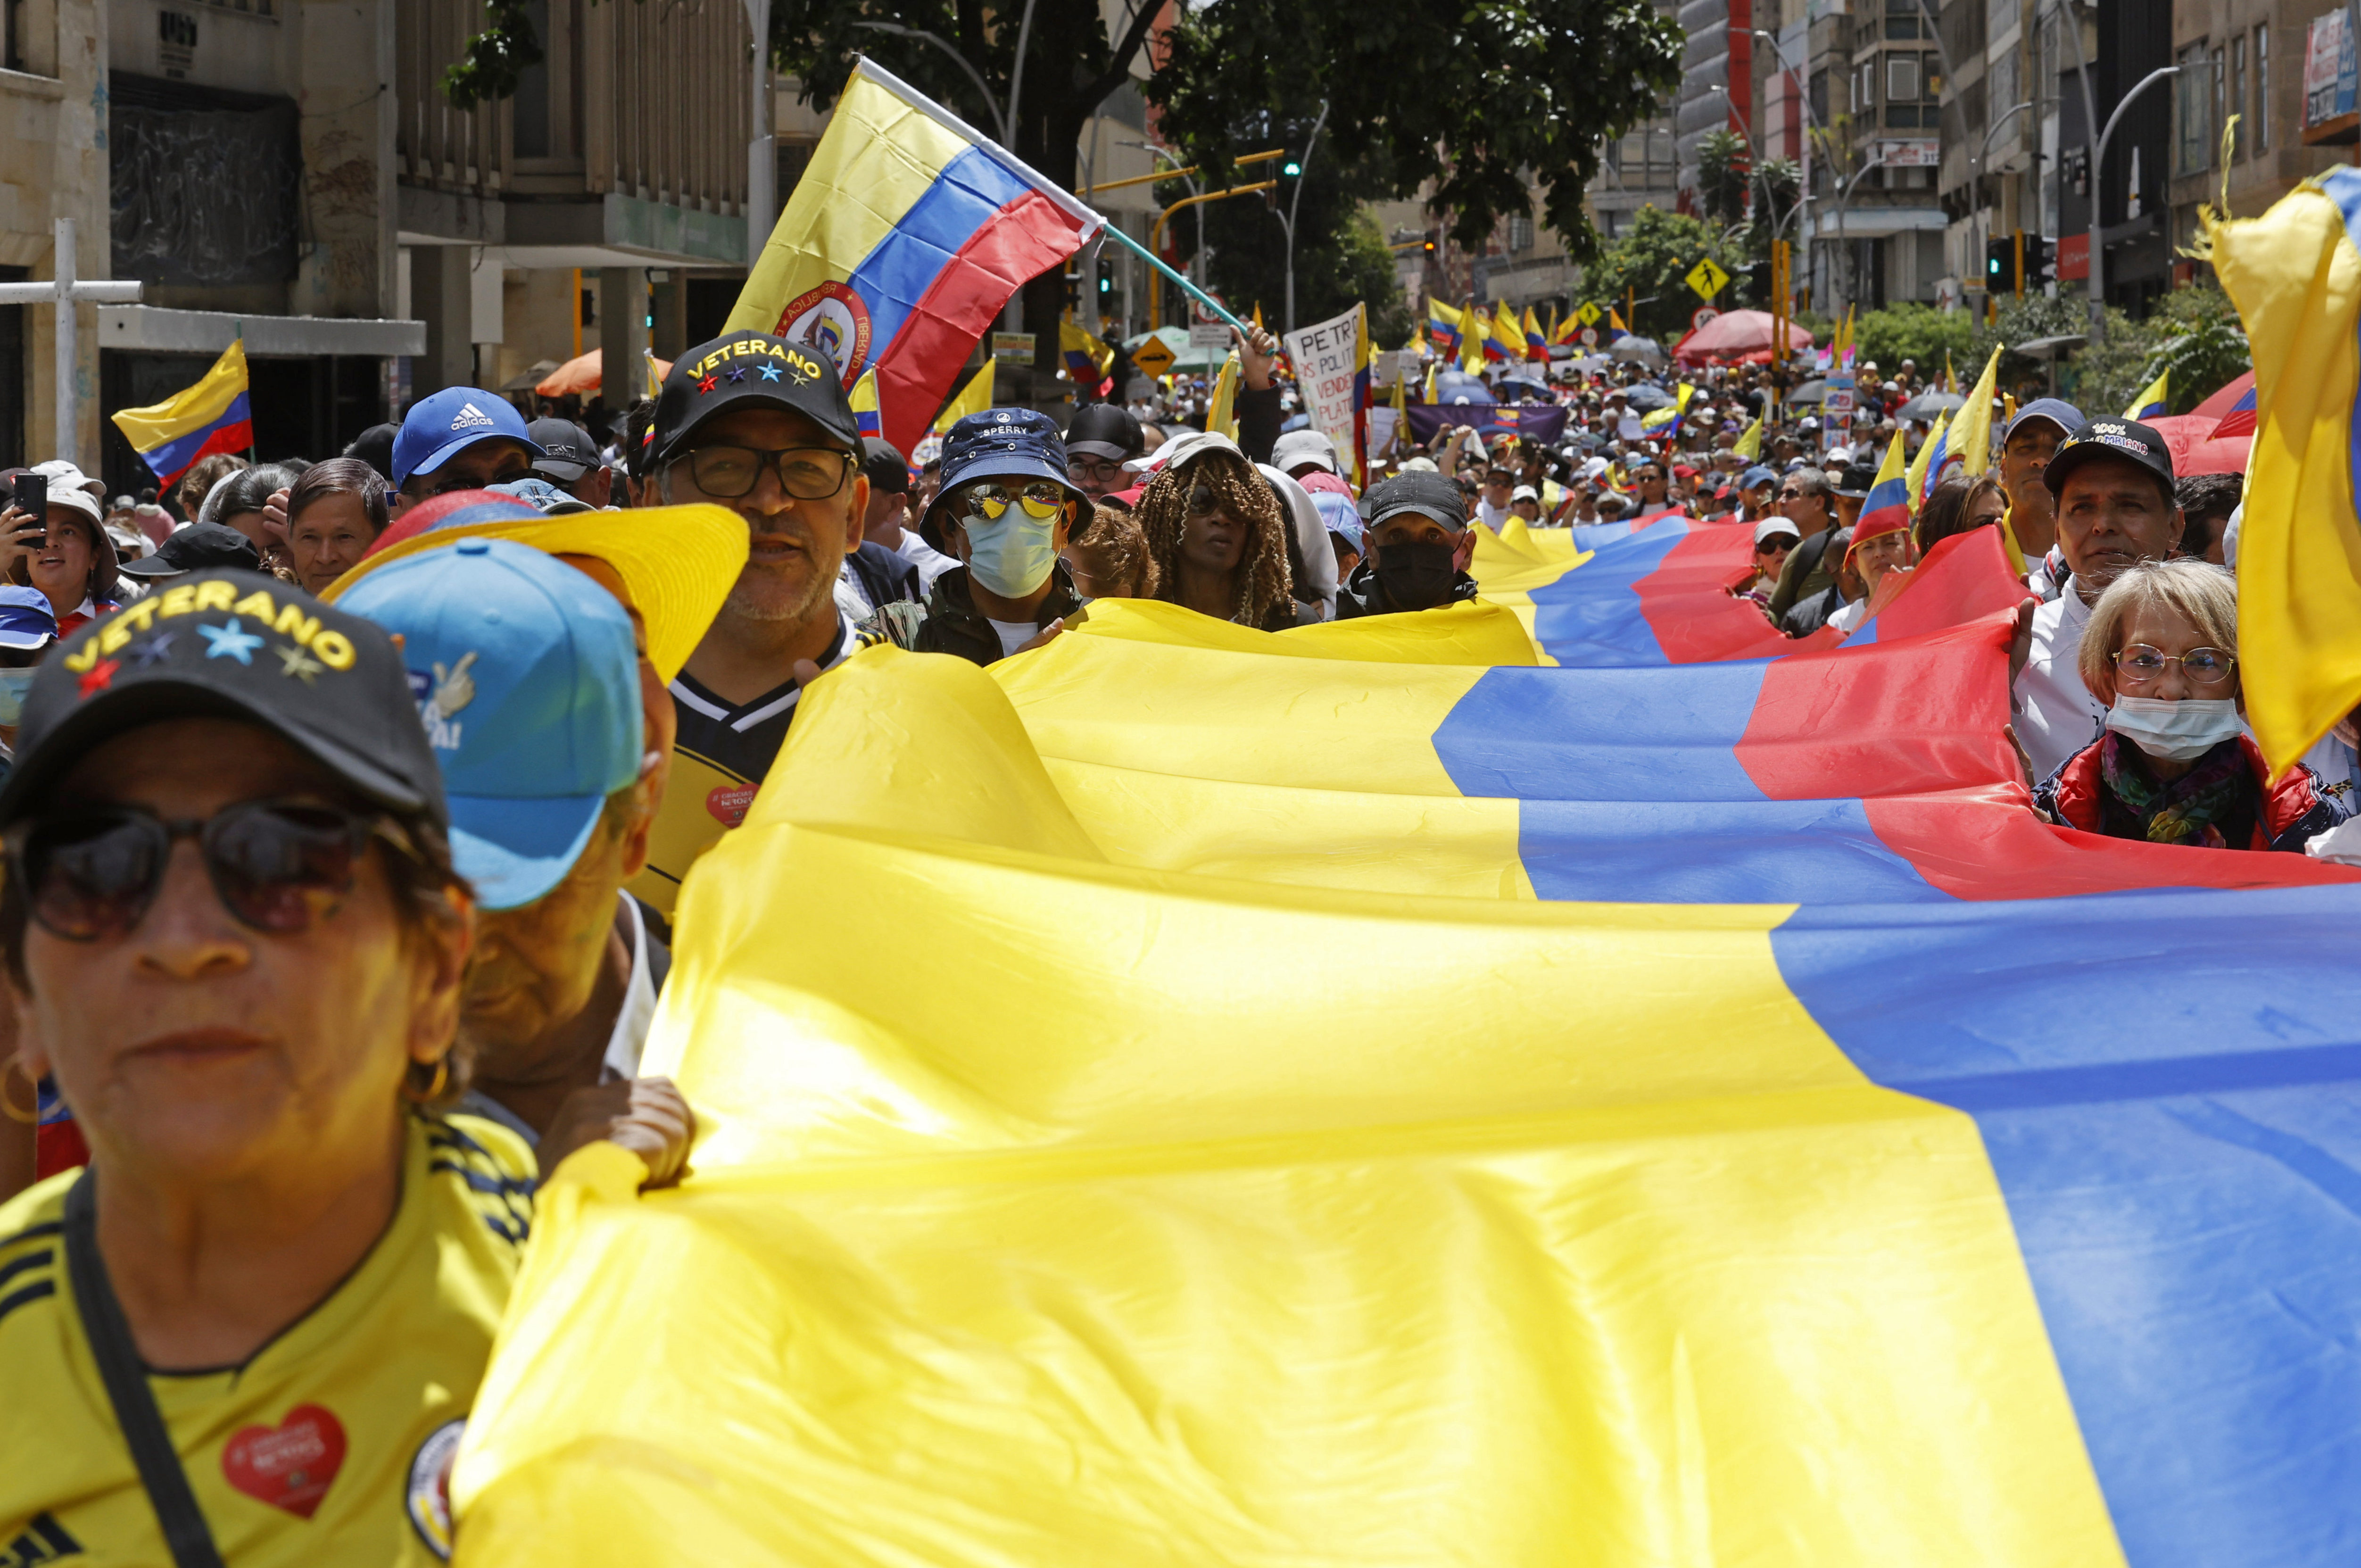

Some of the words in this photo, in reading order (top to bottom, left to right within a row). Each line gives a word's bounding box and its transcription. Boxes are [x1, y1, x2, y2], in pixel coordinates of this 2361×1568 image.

[687, 339, 821, 379] VETERANO
[451, 416, 494, 431] adidas
[984, 425, 1027, 436] SPERRY
[2092, 423, 2126, 435] 100%
[64, 580, 356, 671] VETERANO
